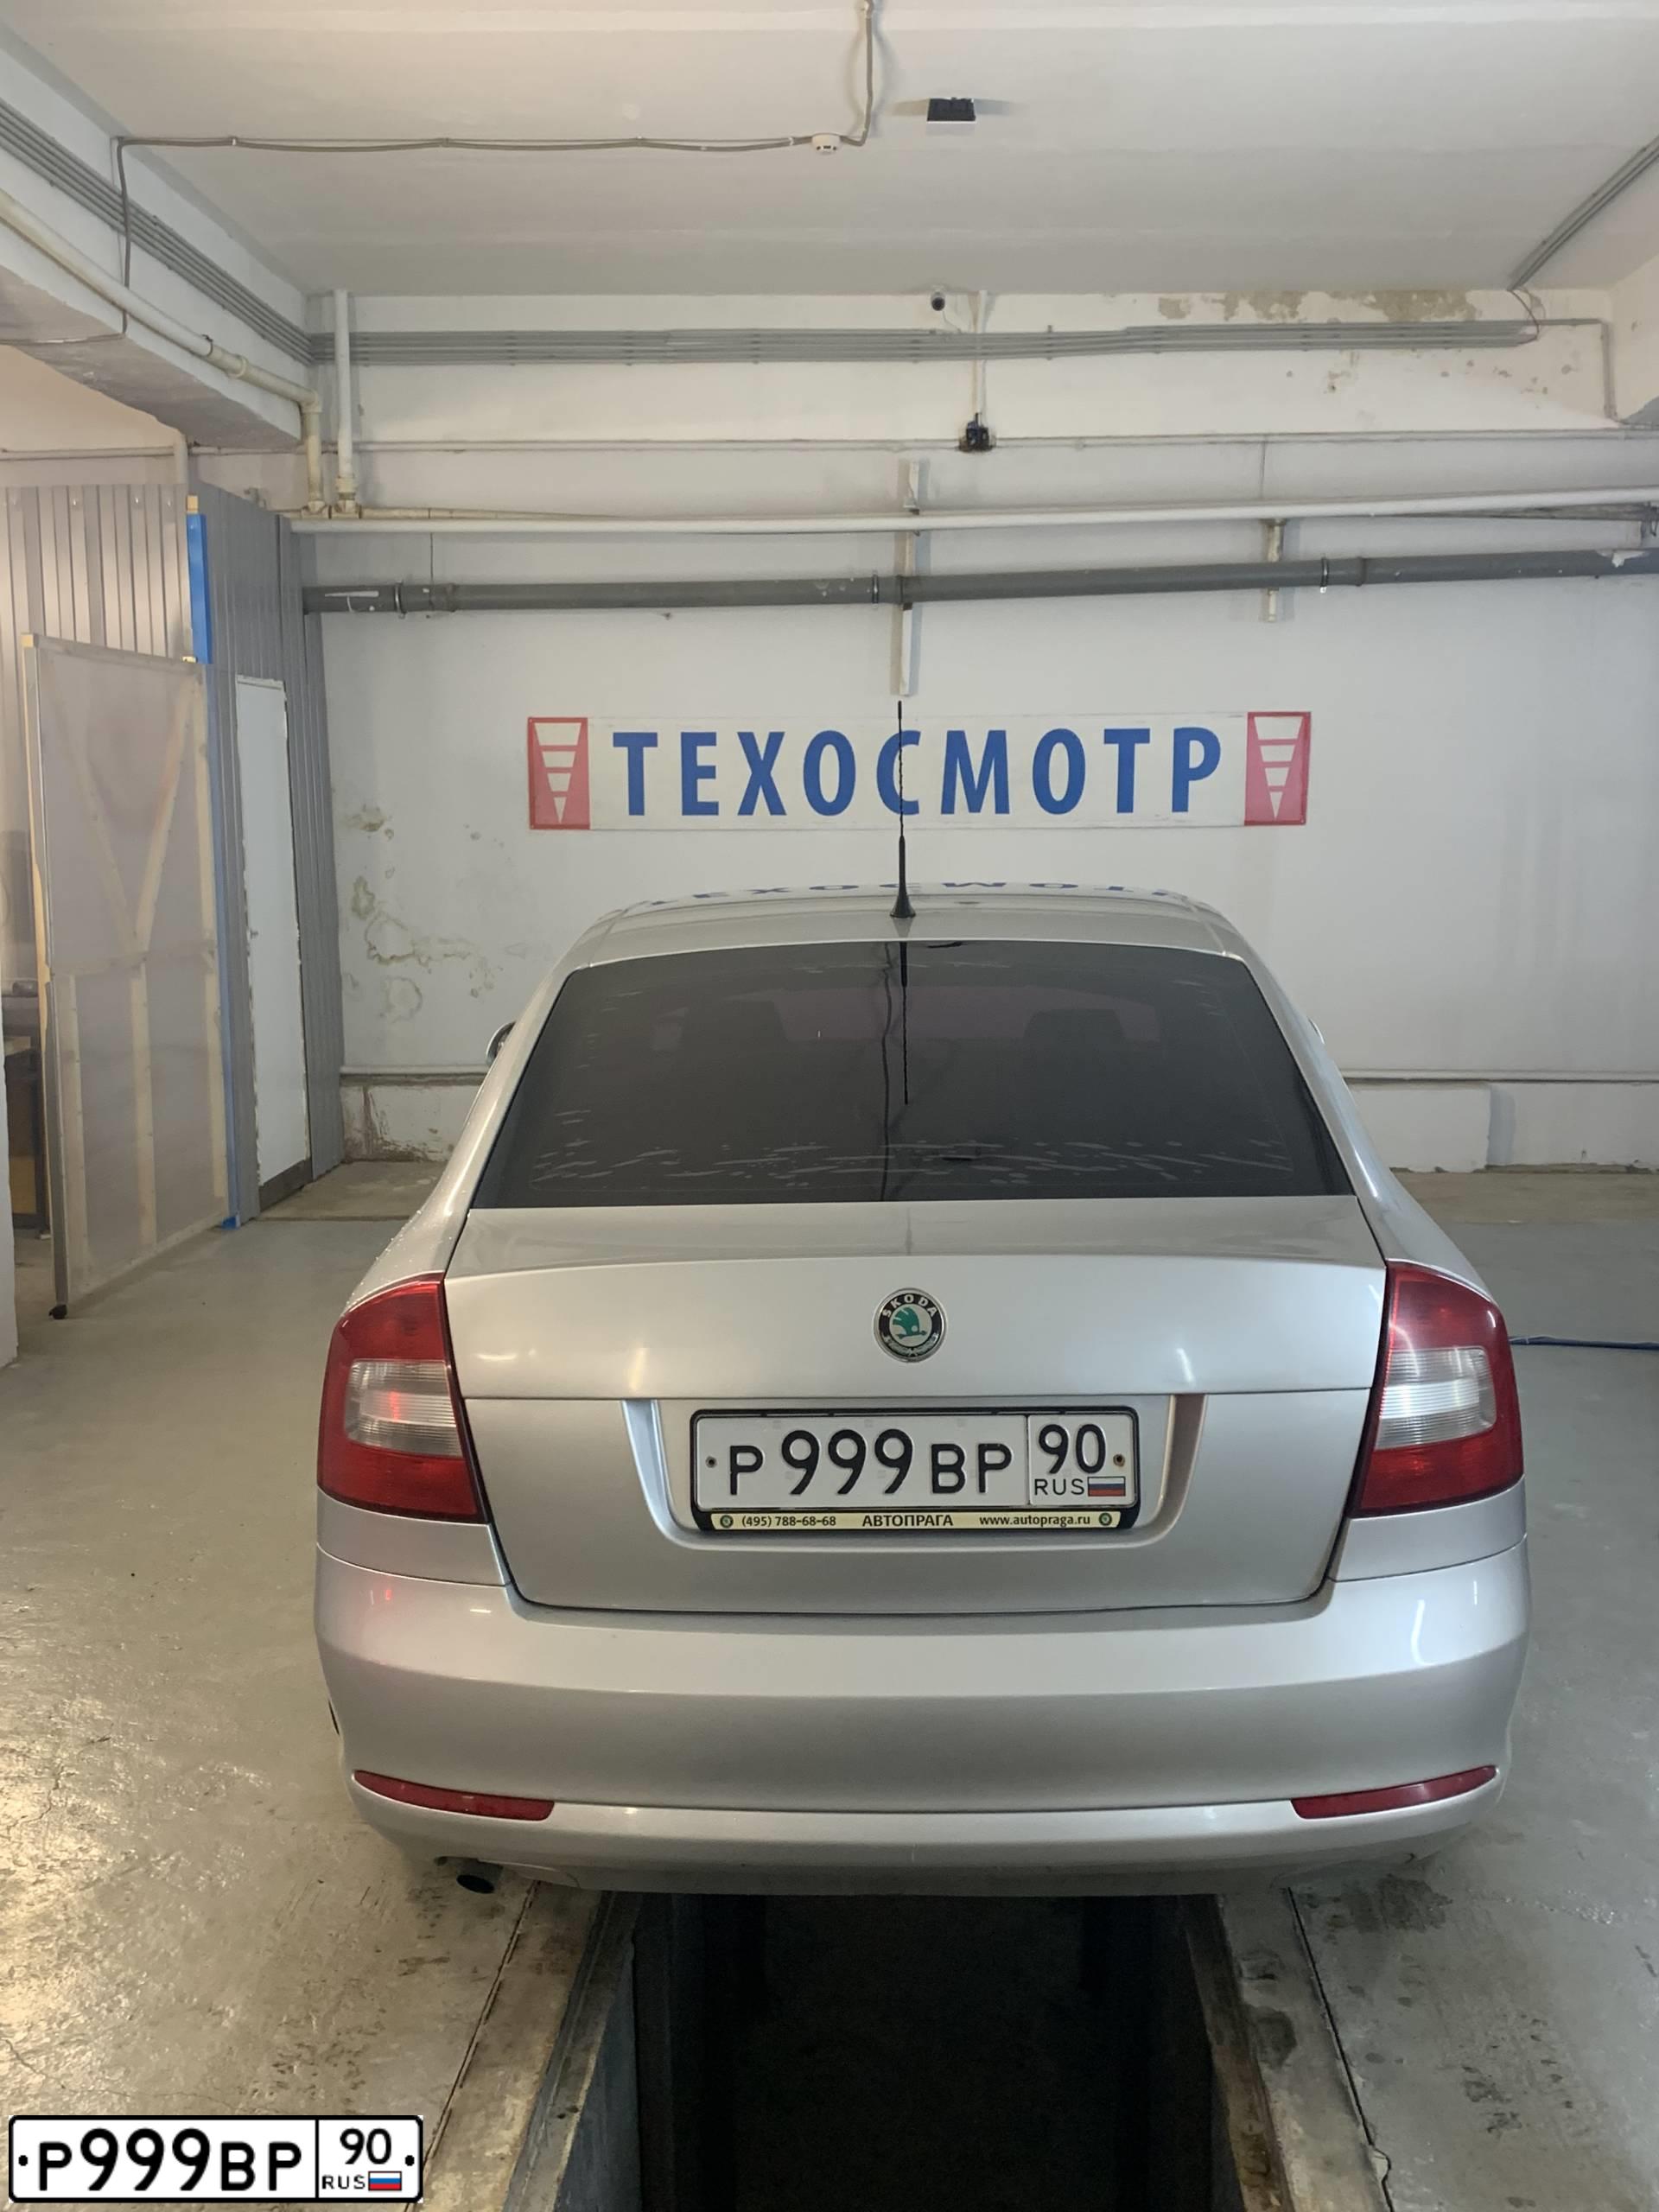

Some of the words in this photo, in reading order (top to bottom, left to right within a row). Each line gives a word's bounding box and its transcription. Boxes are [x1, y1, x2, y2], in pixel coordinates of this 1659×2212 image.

[612, 727, 1222, 817] ТЕХОСМОТР
[729, 1428, 1013, 1496] Р999ВР
[1038, 1423, 1107, 1474] 90
[1033, 1478, 1085, 1497] RUS
[741, 1516, 772, 1528] (495)
[776, 1516, 836, 1527] 788-68-68
[861, 1514, 954, 1528] АВТОПРАГА
[979, 1514, 1091, 1527] www.autopraga.ru
